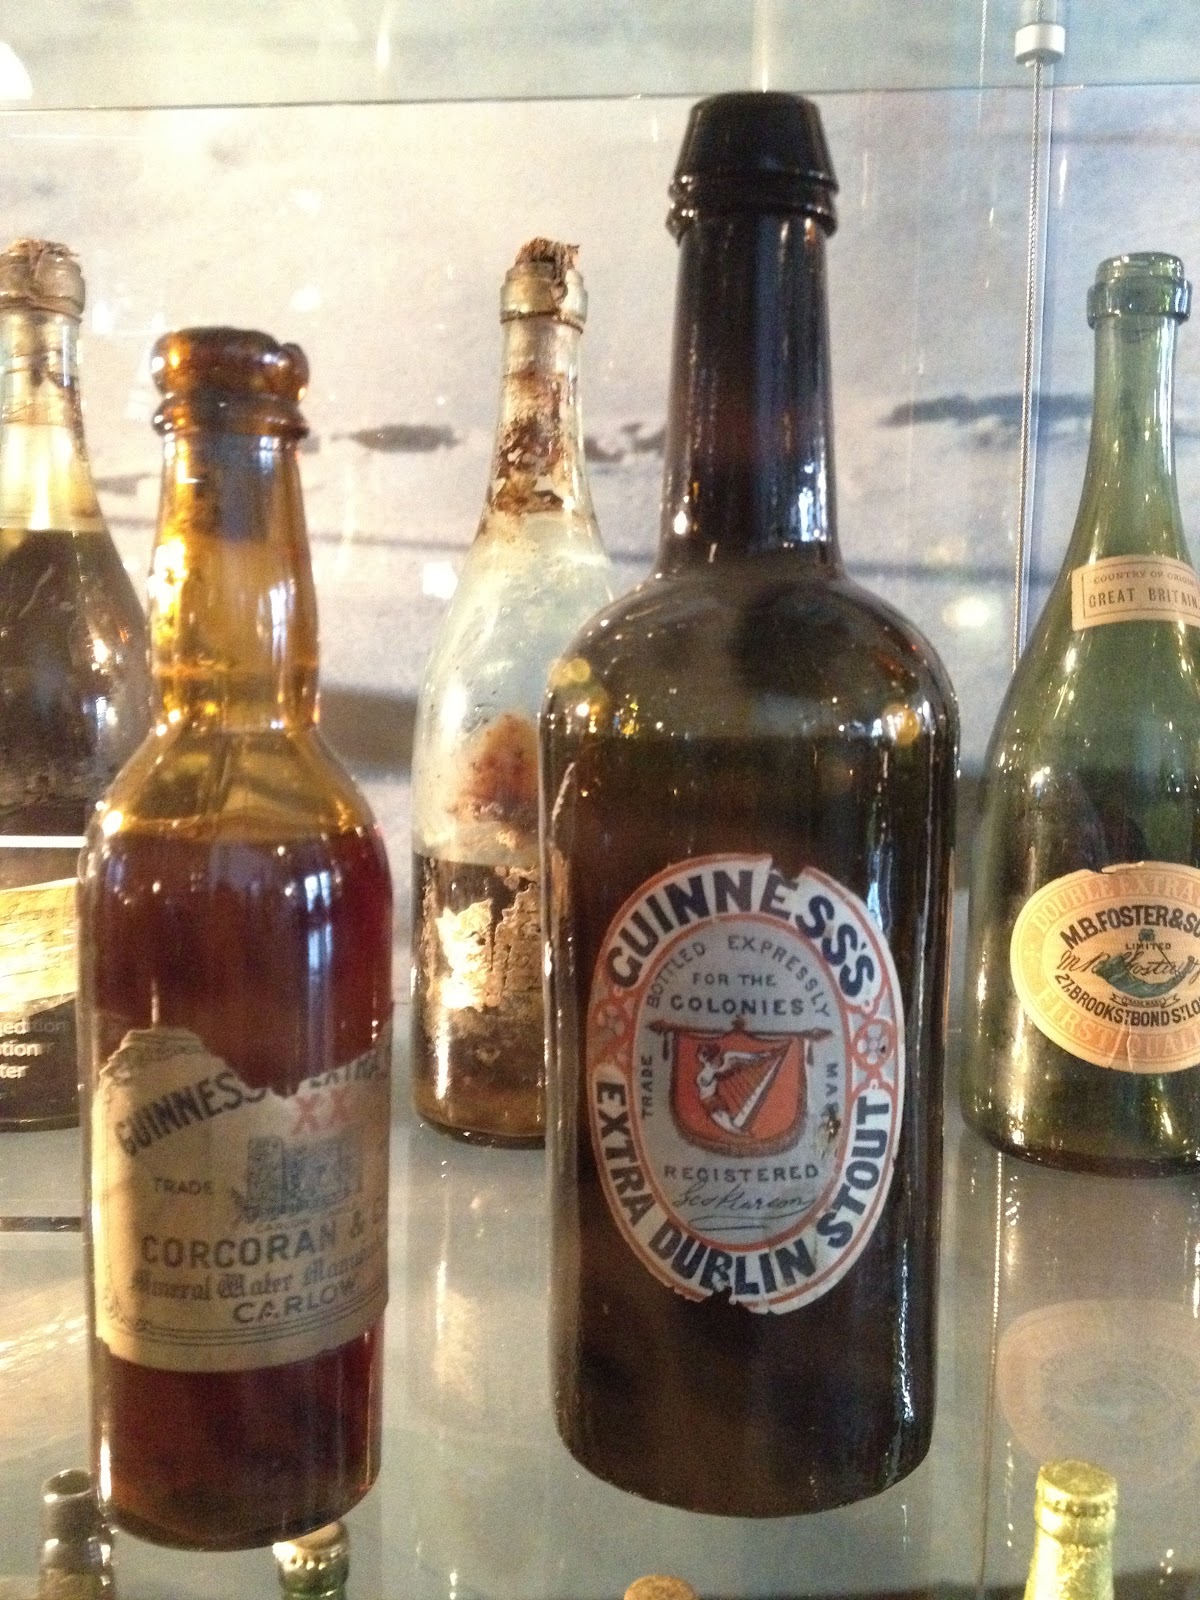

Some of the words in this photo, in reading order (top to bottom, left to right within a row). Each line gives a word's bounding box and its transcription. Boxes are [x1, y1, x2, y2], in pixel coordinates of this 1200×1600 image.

[1088, 587, 1135, 609] GREAT
[606, 868, 876, 998] GUINNESS'S
[646, 941, 707, 1010] BOTTLED
[727, 934, 831, 1018] EXPRESSLY
[692, 972, 730, 986] FOR
[738, 973, 777, 987] THE
[669, 994, 804, 1017] COLONIES
[640, 1055, 653, 1119] TRADE
[596, 1081, 656, 1226] EXTRA
[648, 1218, 817, 1295] DUBLIN
[816, 1095, 890, 1249] STOUT
[664, 1164, 819, 1183] REGISTERED
[139, 1218, 337, 1270] CORCORAN
